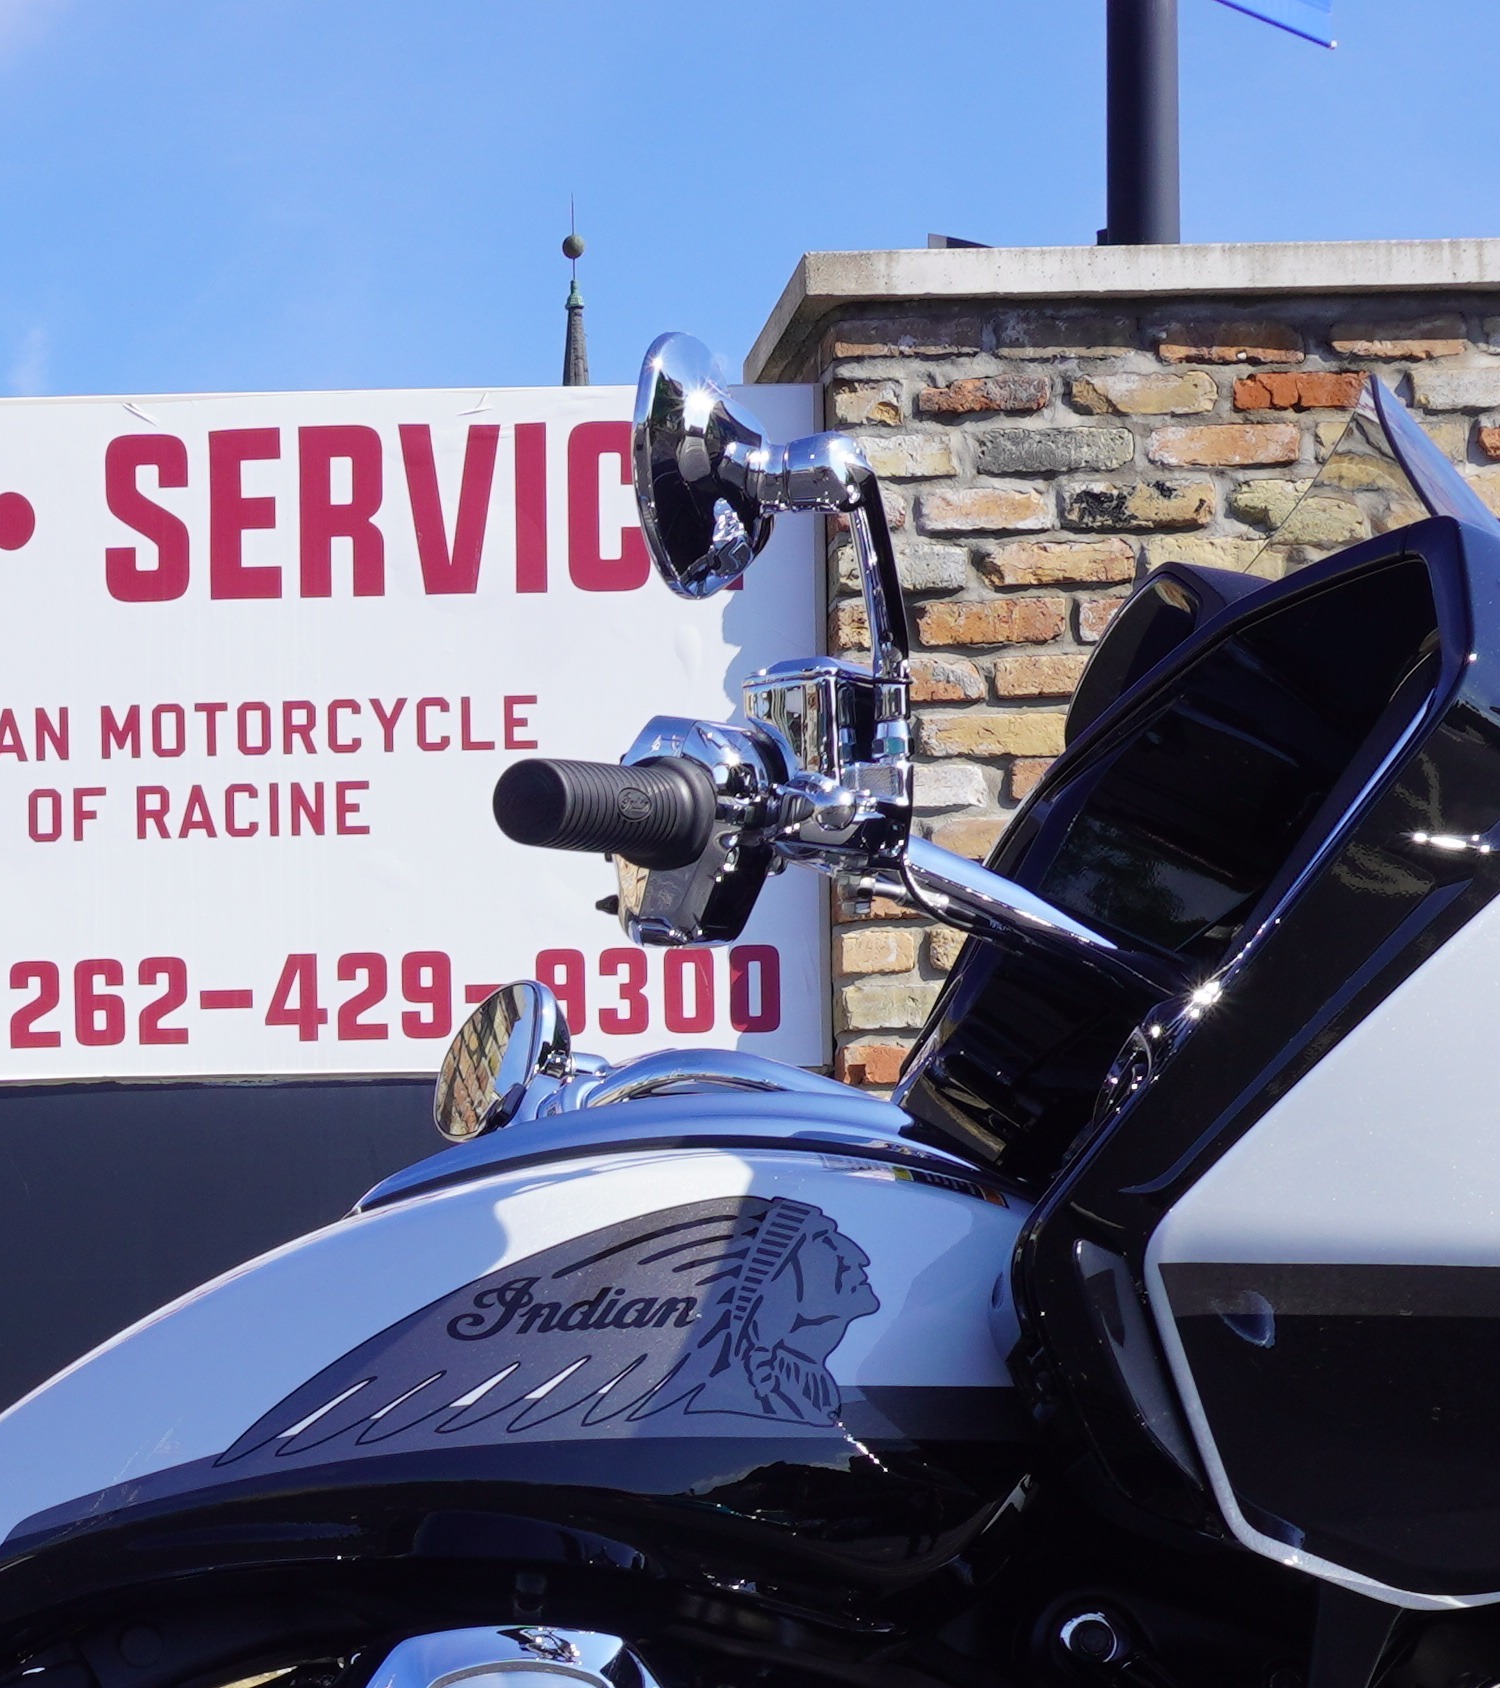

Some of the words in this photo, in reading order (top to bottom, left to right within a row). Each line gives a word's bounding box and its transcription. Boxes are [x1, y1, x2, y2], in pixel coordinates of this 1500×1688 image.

[106, 421, 743, 603] SERVIC
[100, 695, 537, 759] MOTORCYCLE
[28, 787, 107, 843] OF
[136, 781, 370, 839] RACINE
[9, 947, 780, 1049] 262-429-9300
[446, 1276, 697, 1342] Indian
